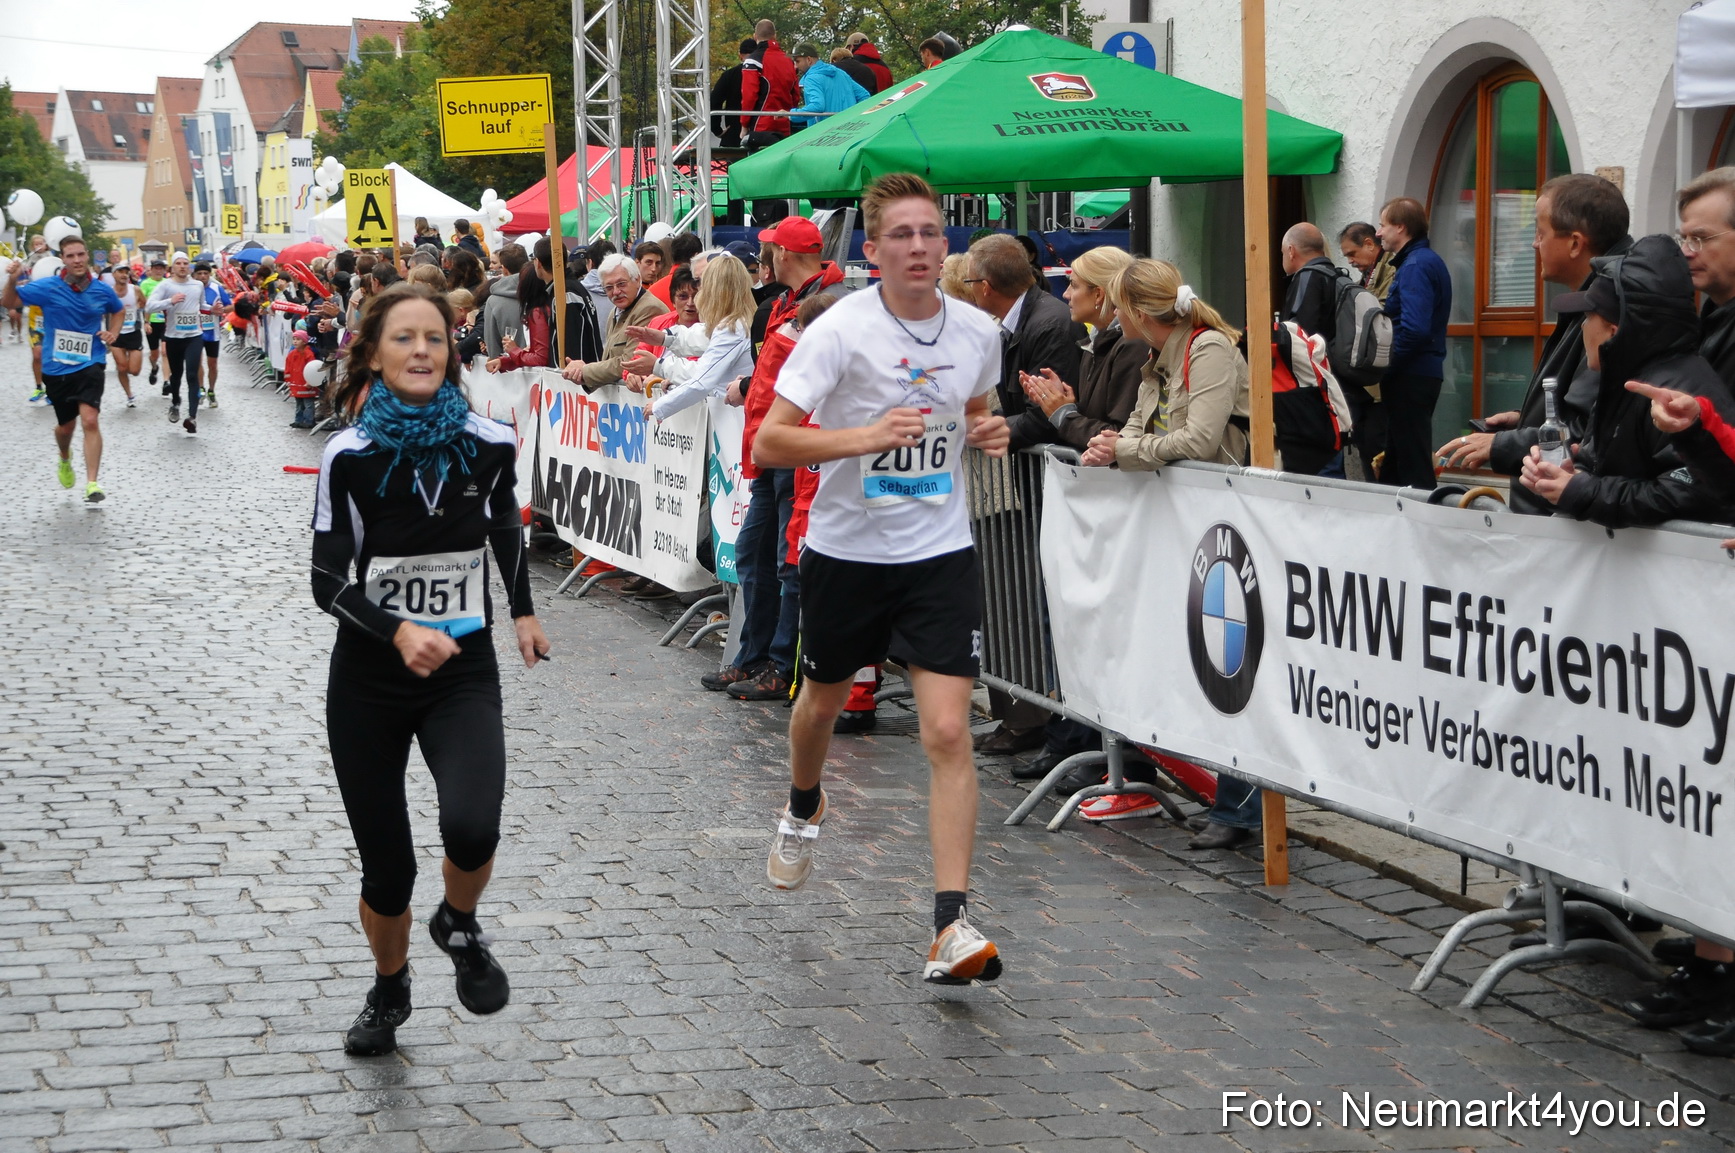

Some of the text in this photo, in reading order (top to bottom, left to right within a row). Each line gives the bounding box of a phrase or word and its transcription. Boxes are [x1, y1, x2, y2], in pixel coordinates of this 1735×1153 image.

[446, 100, 543, 117] Schnupper-
[1011, 106, 1153, 122] Neumarkter
[481, 119, 512, 135] lauf
[992, 117, 1192, 137] Lammsbräu
[349, 172, 390, 187] Block
[227, 214, 238, 229] B
[357, 193, 388, 231] A
[58, 338, 88, 354] 3040
[560, 390, 648, 465] INTESPORT
[870, 436, 948, 472] 2016
[653, 463, 664, 485] Im
[664, 465, 688, 492] Herzen
[878, 479, 939, 495] Sebastian
[655, 490, 666, 512] der
[412, 562, 467, 573] Neumarkt
[719, 555, 737, 571] Ser
[1192, 527, 1257, 594] BMW
[379, 575, 469, 616] 2051
[1284, 559, 1407, 662] BMW
[1287, 662, 1722, 837] Weniger Verbrauch. Mehr
